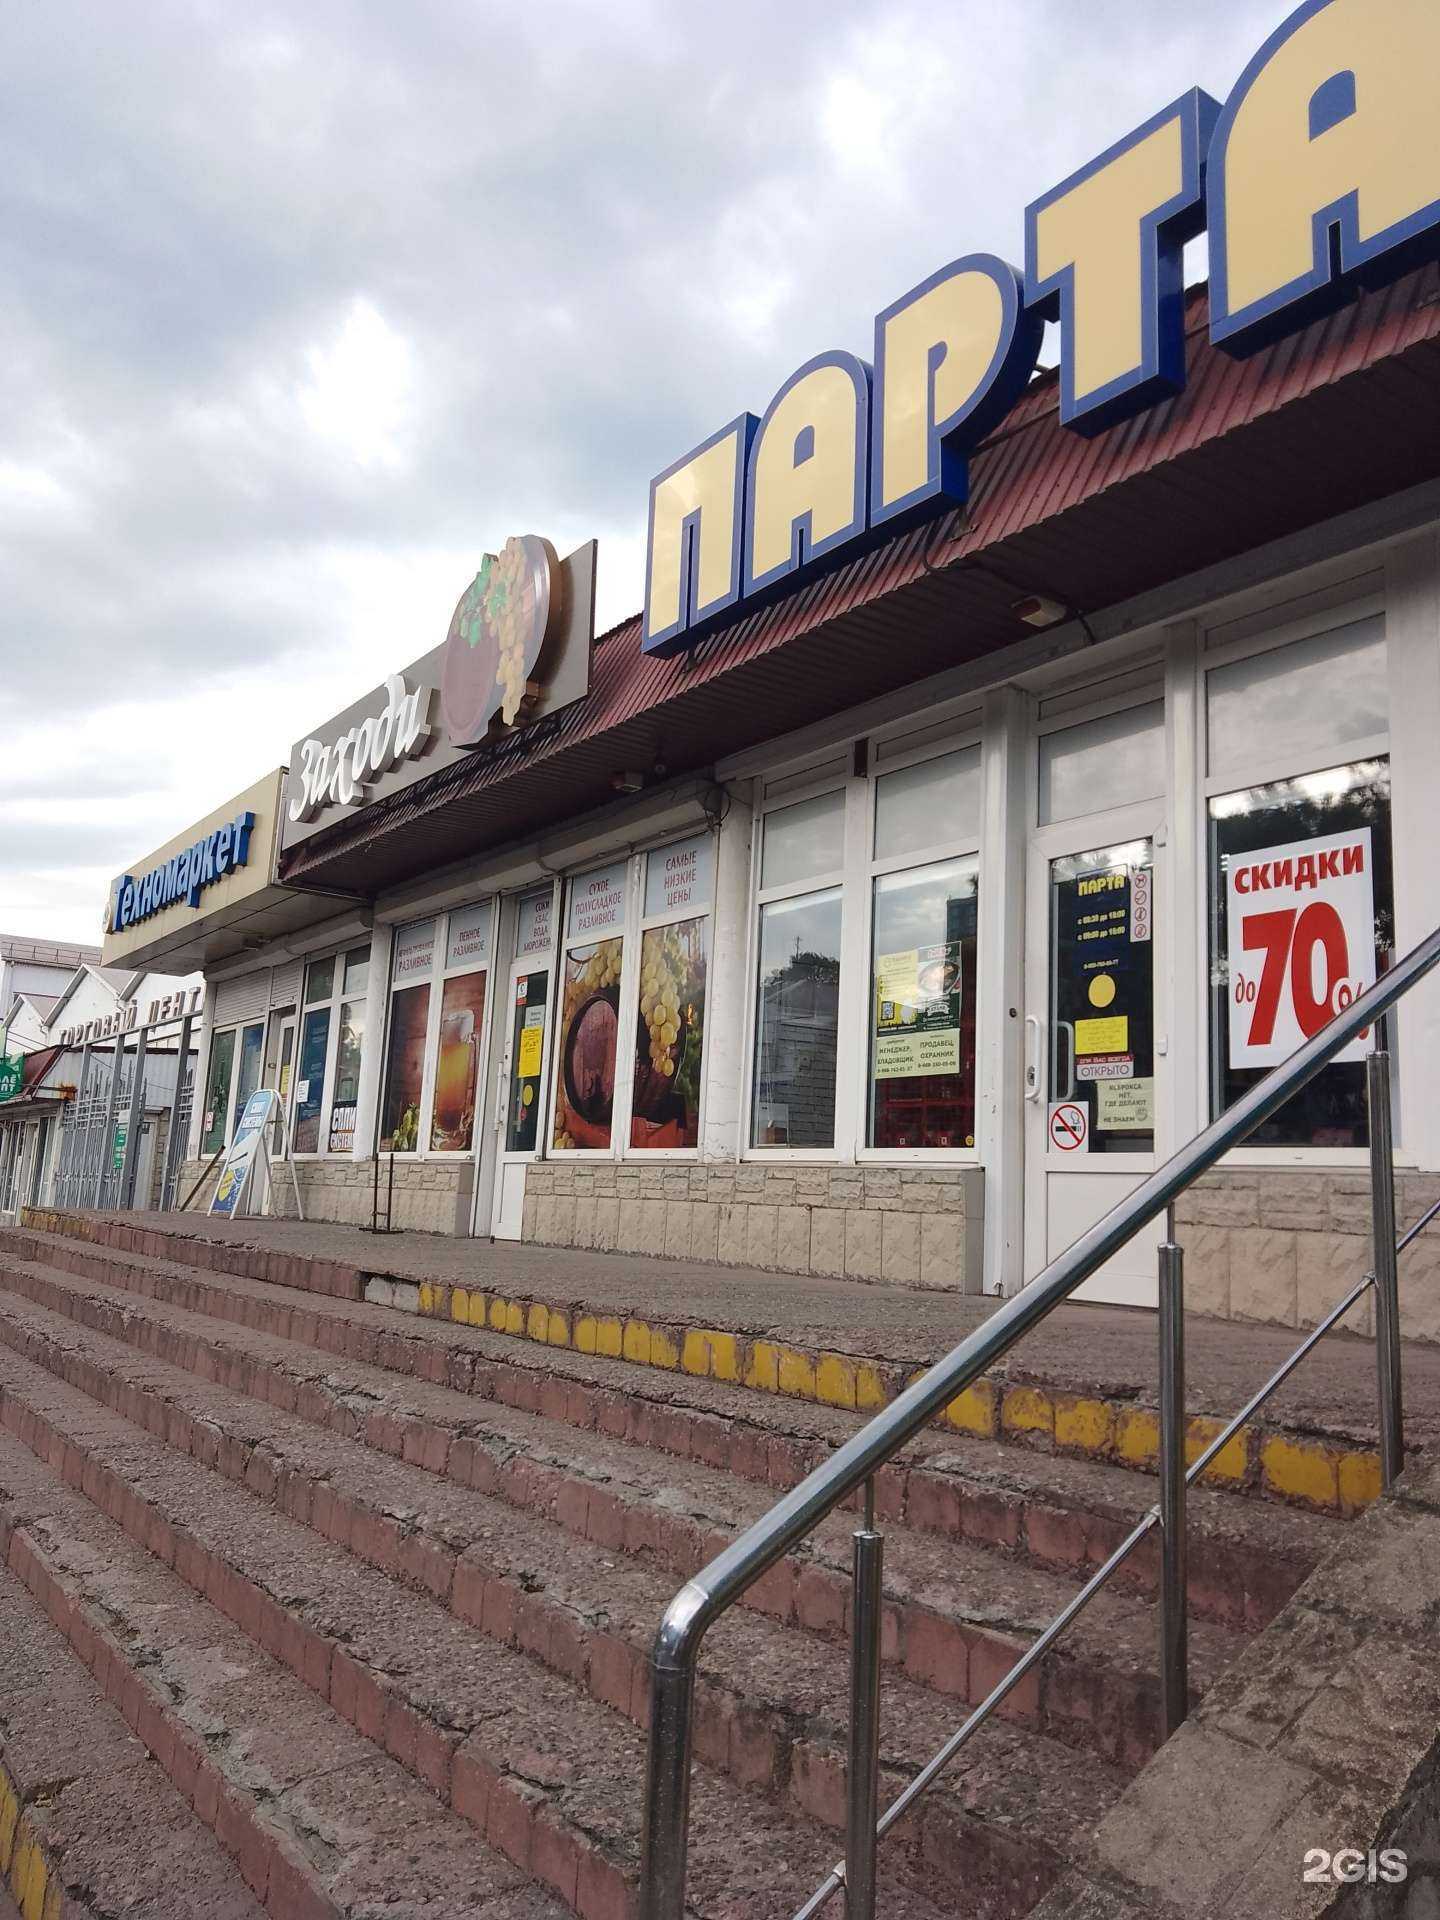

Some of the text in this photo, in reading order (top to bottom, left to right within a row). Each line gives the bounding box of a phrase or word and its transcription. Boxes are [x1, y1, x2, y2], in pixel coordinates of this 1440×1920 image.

[642, 0, 1440, 656] ПАРТА
[289, 674, 438, 822] Заходи
[112, 811, 256, 932] Техномаркет
[664, 852, 697, 872] САМЫЕ
[1234, 844, 1364, 895] СКИДКИ
[588, 878, 610, 896] СУХОЕ
[664, 869, 697, 890] НИЗКИЕ
[1078, 874, 1125, 896] ПАРТА
[575, 891, 622, 915] ПОЛУСЛАДКОЕ
[667, 887, 692, 909] ЦЕНЫ
[577, 909, 616, 930] РАЗЛИВНОЕ
[459, 928, 481, 942] ПЕННОЕ
[453, 940, 485, 958] РАЗЛИВНОЕ
[1235, 973, 1255, 1004] до
[58, 999, 138, 1045] ТОРГОВЫЙ
[920, 1050, 954, 1059] ОХРАННИК
[1081, 1064, 1129, 1077] ОТКРЫТО
